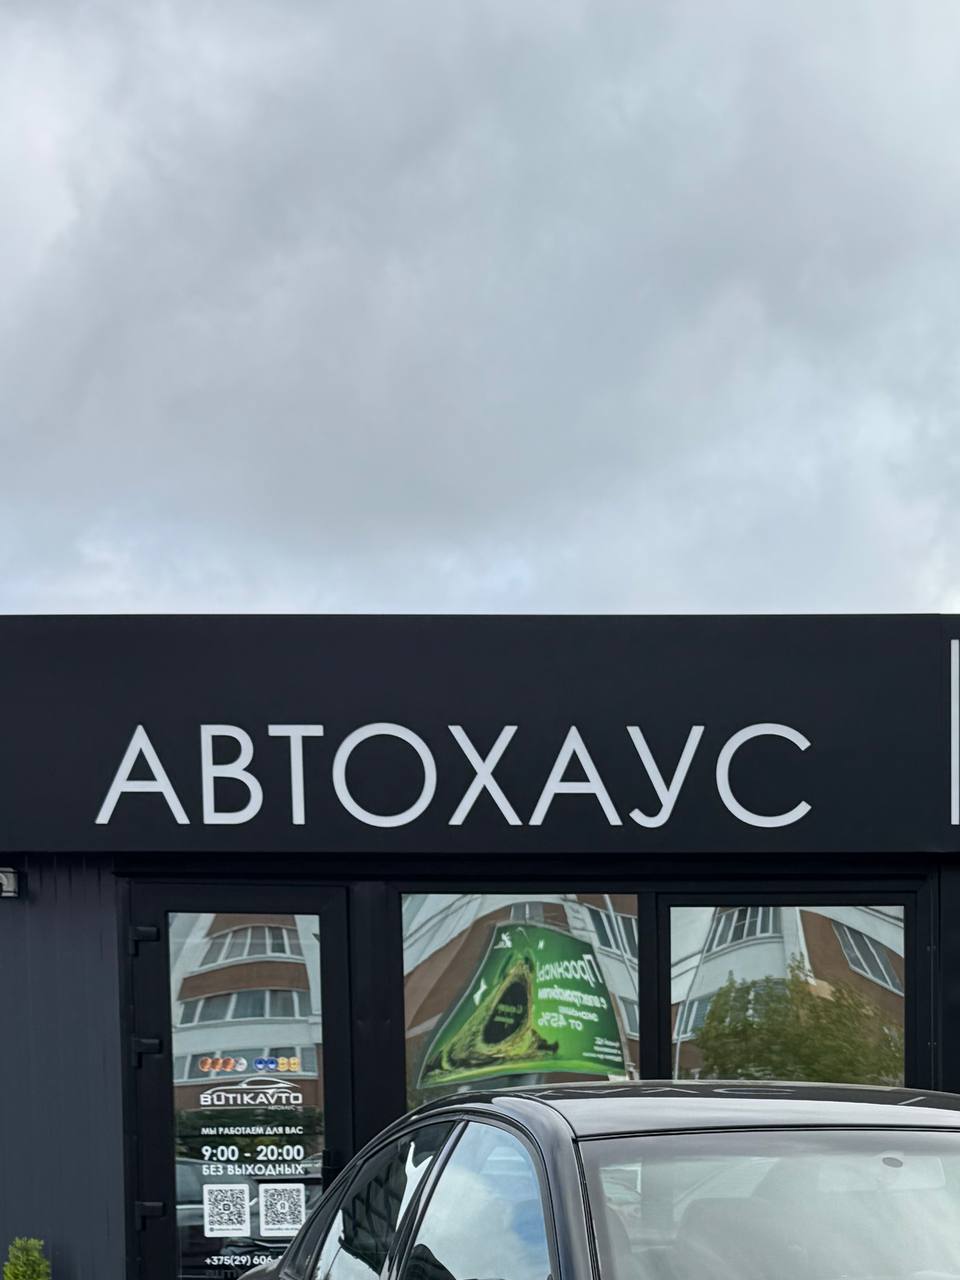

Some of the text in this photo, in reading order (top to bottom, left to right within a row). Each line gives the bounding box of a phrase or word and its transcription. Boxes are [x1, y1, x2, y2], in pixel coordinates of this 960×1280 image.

[95, 722, 812, 829] АВТОХАУС
[200, 1092, 303, 1106] BUTIKAVTO
[201, 1126, 304, 1135] МЫ РАБОТАЕМ ДЛЯ ВАС
[201, 1145, 239, 1161] 9:00
[256, 1145, 304, 1161] 20:00
[202, 1164, 305, 1176] БЕЗ ВЫХОДНЫХ
[204, 1256, 251, 1267] +375(29)
